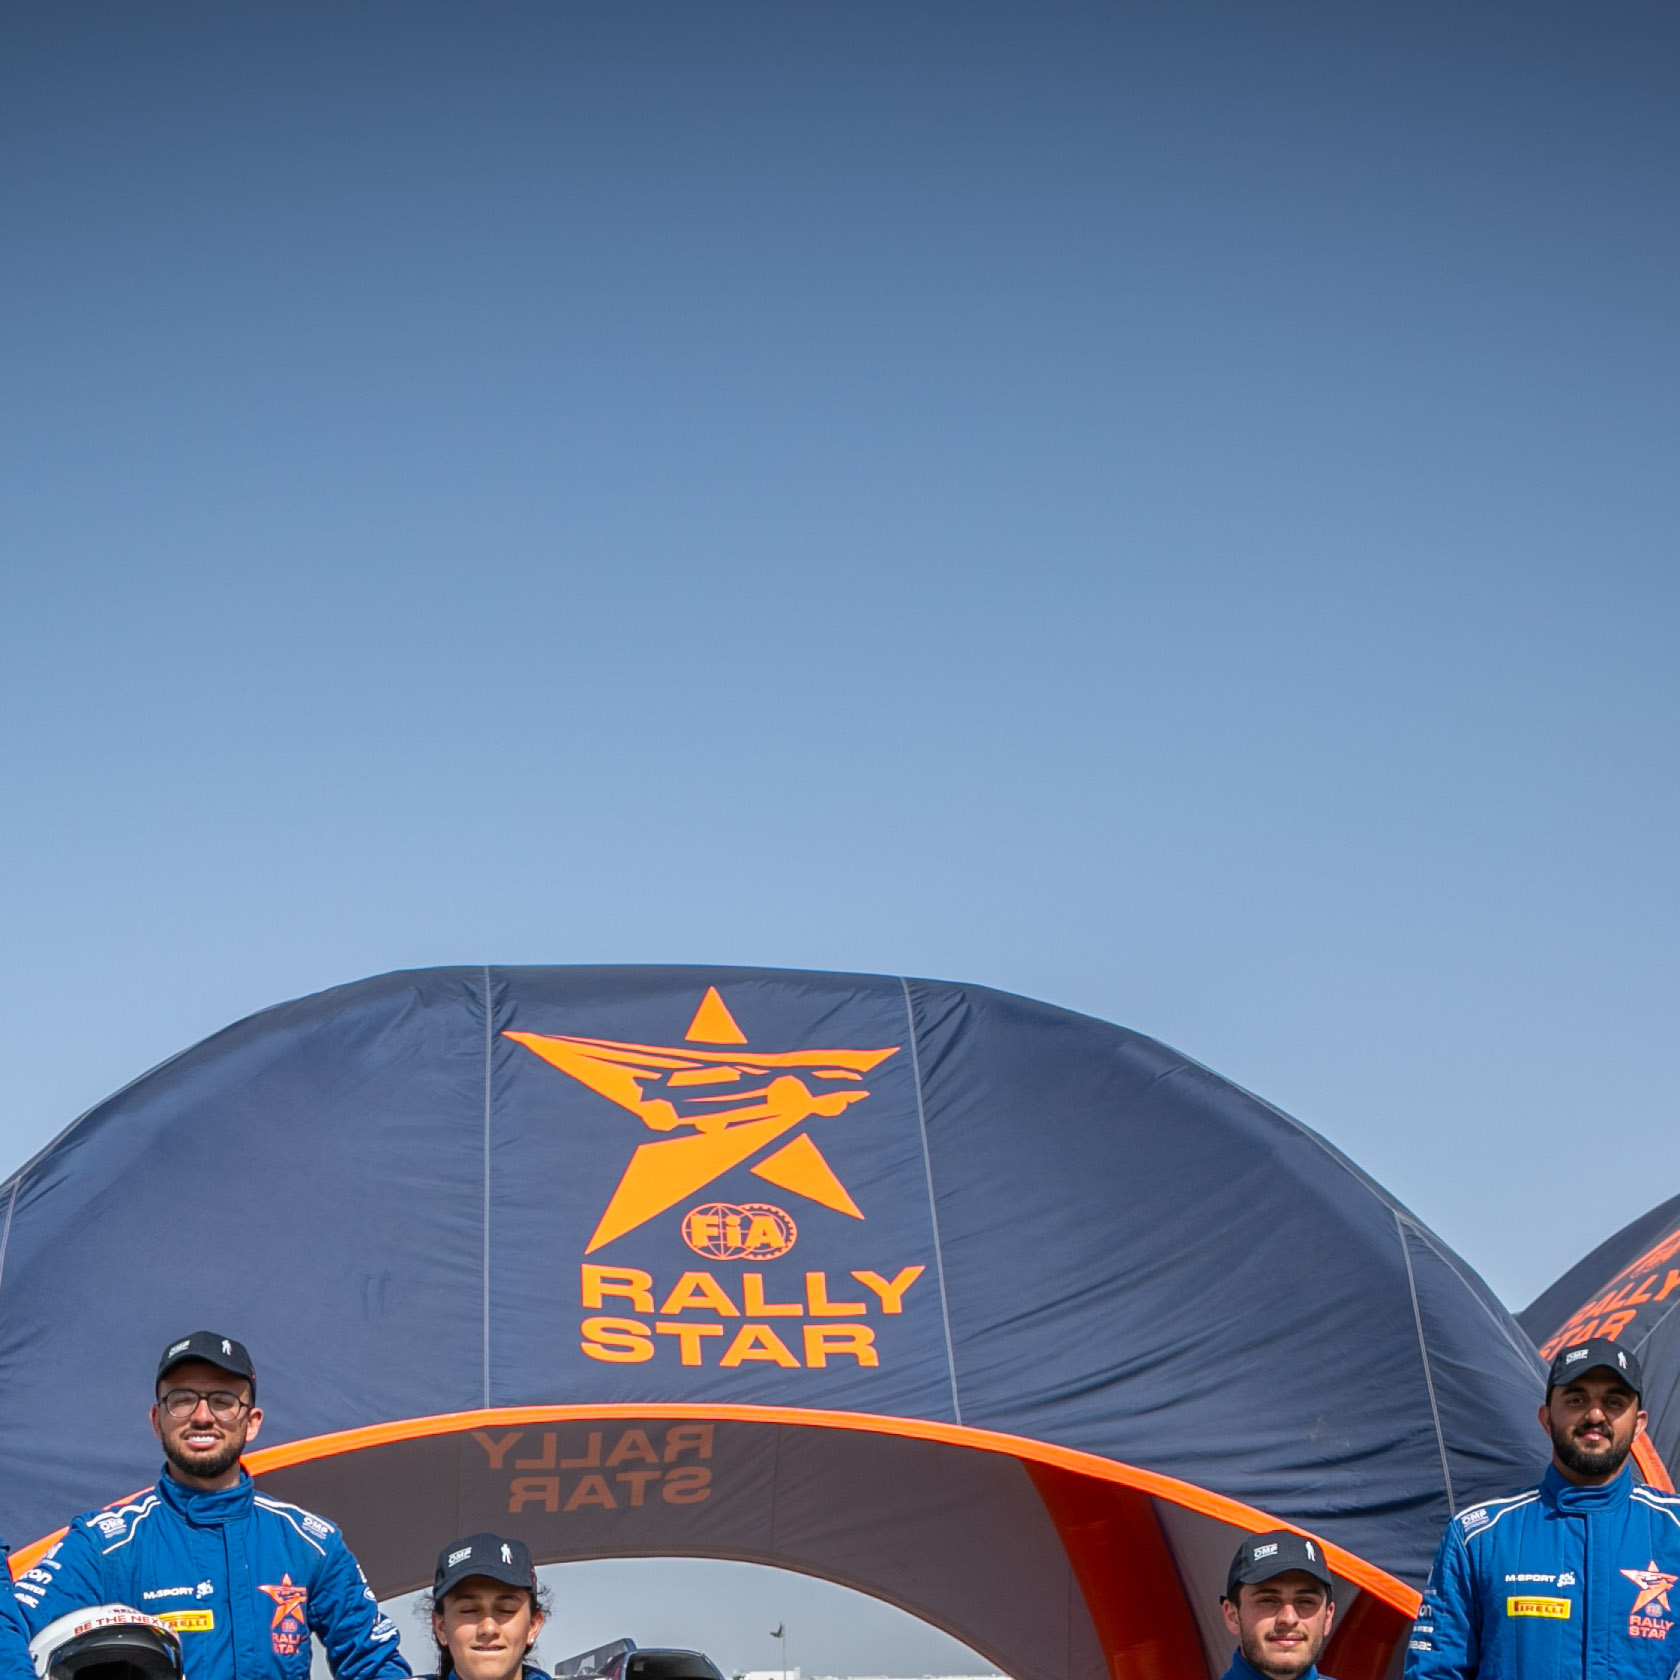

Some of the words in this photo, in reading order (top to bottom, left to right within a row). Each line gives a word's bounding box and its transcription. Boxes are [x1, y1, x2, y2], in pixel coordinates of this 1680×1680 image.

[580, 1264, 925, 1317] RALLY
[580, 1318, 879, 1368] STAR
[1461, 1509, 1487, 1525] OMP
[448, 1548, 472, 1564] OMP
[1254, 1546, 1278, 1558] OMP
[1505, 1574, 1556, 1583] M-SPORT
[143, 1587, 194, 1600] M-SPORT
[1514, 1601, 1564, 1614] PIRELLI
[74, 1622, 92, 1635] BE
[96, 1615, 127, 1626] THE
[169, 1616, 208, 1628] RELLI
[1629, 1615, 1674, 1629] RALLY
[1629, 1626, 1667, 1640] STAR
